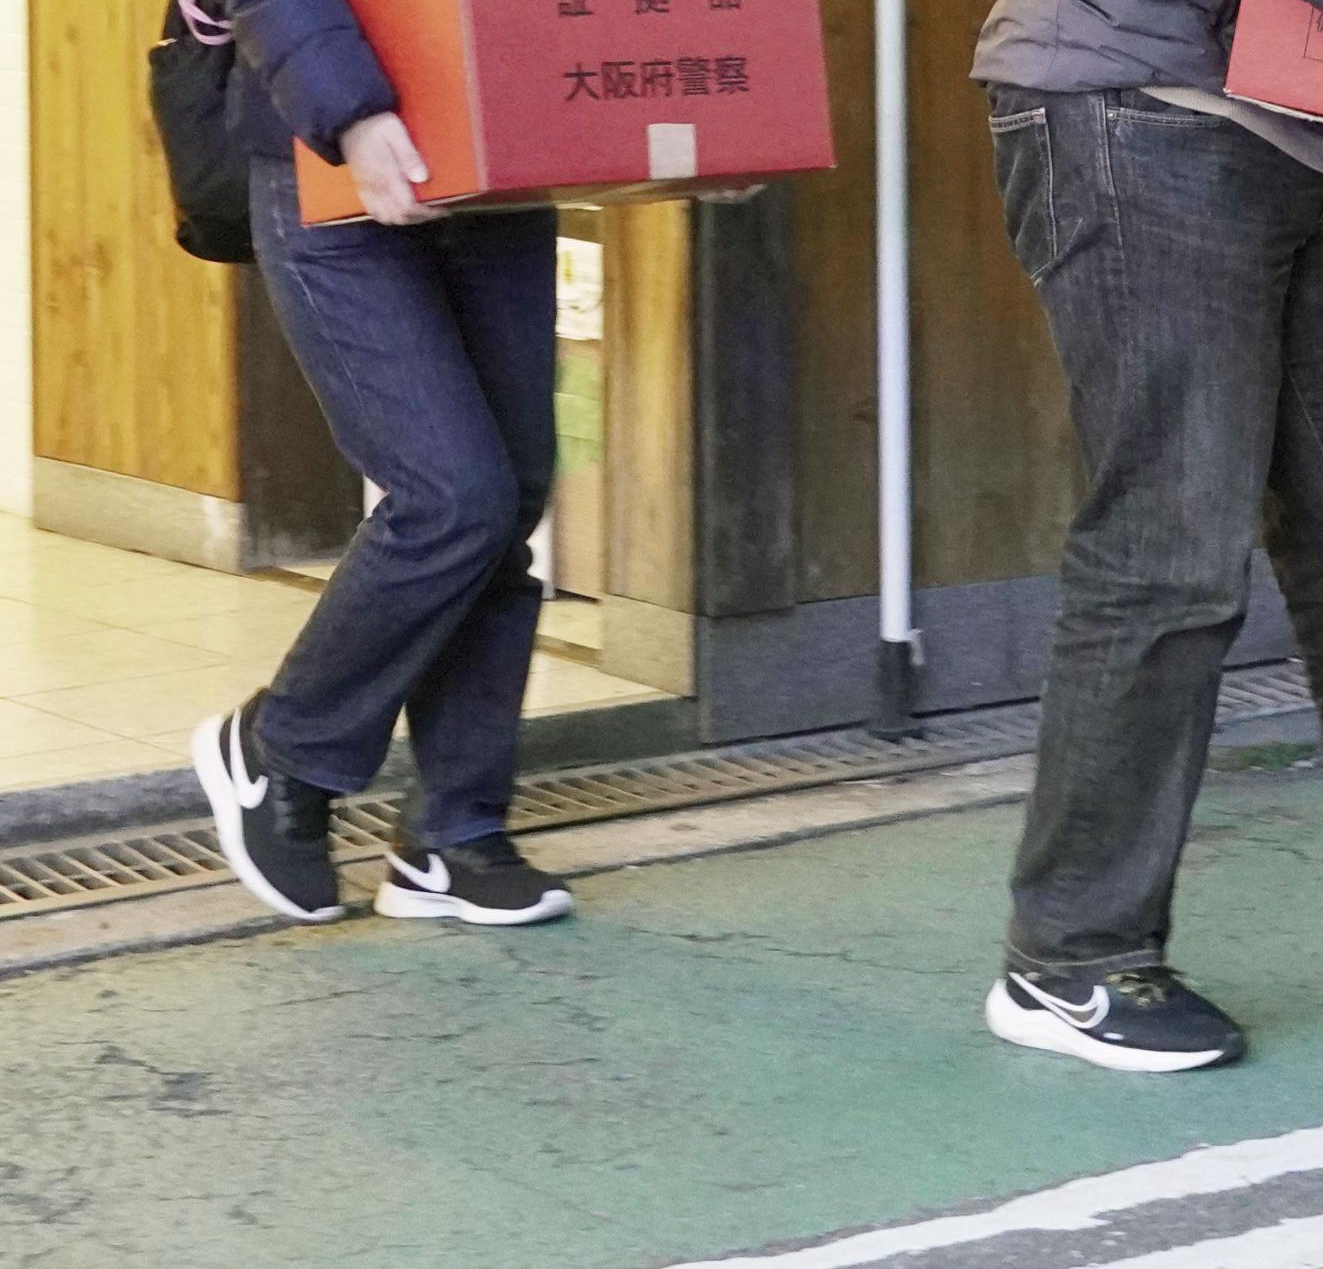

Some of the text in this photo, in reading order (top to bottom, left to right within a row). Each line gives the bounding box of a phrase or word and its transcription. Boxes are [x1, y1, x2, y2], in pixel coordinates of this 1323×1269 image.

[563, 56, 750, 102] 大阪府警察
